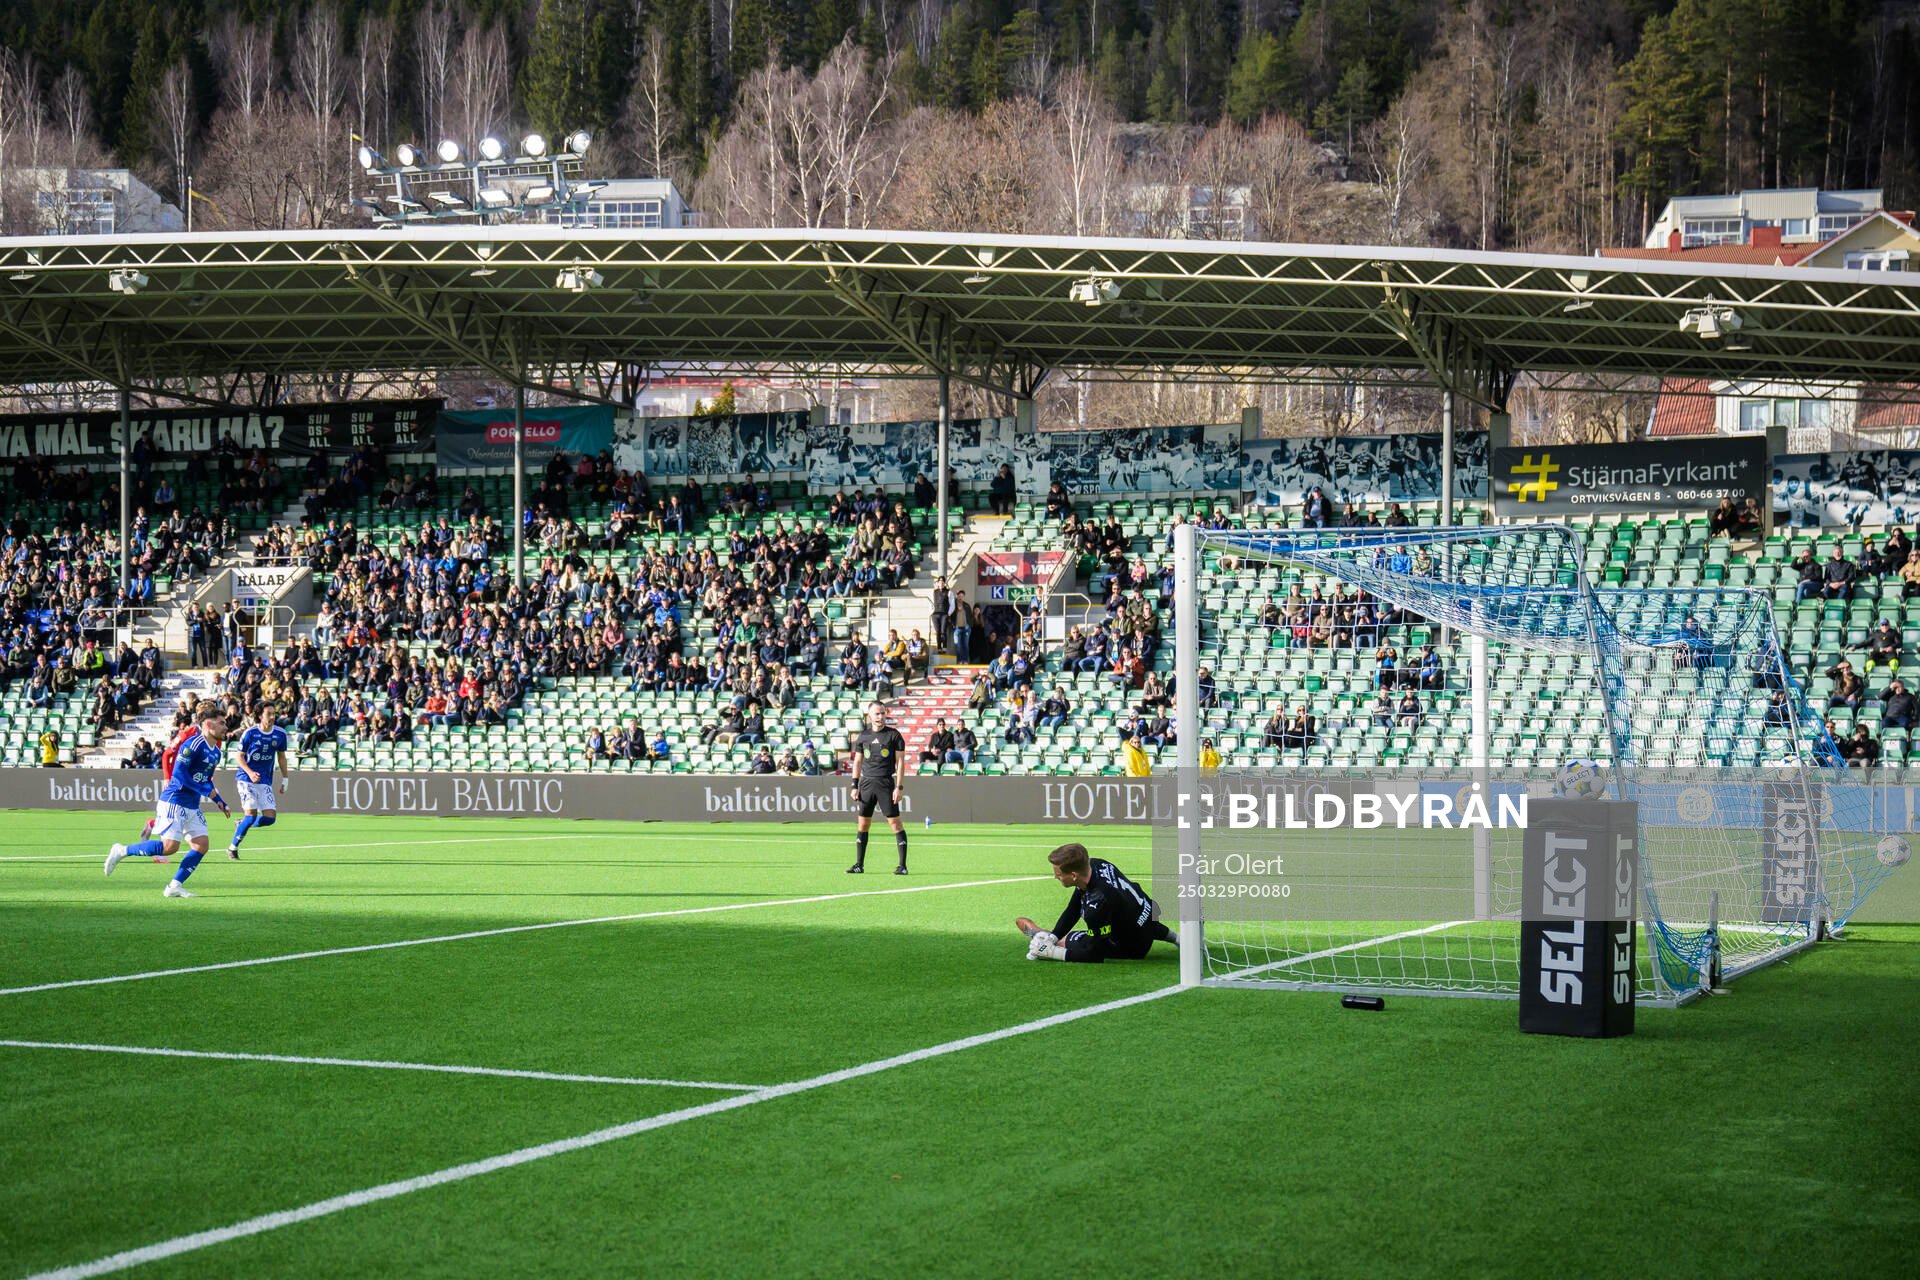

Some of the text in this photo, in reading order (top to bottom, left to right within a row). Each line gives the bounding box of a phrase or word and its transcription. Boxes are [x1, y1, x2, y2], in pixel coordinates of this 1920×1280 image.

[35, 416, 104, 456] MÅL.
[110, 417, 211, 454] SKARU
[396, 433, 418, 444] ALL
[490, 426, 556, 439] PORELLO
[309, 437, 331, 448] ALL
[352, 436, 374, 446] ALL
[1570, 491, 1651, 504] ORTVIKSVÄGEN
[1654, 491, 1661, 501] 8
[1677, 490, 1713, 500] 060-66
[1715, 489, 1729, 498] 37
[1732, 488, 1745, 498] 00
[981, 564, 1018, 577] JUMP
[237, 573, 286, 587] HÅLAB
[993, 586, 1003, 599] K
[1566, 769, 1591, 785] SELECT
[331, 777, 563, 813] HOTEL BALTIC
[1042, 782, 1172, 820] HOTEL
[1776, 799, 1806, 905] SELECT
[1540, 831, 1588, 1005] SELECT
[1613, 833, 1633, 1005] SELECT
